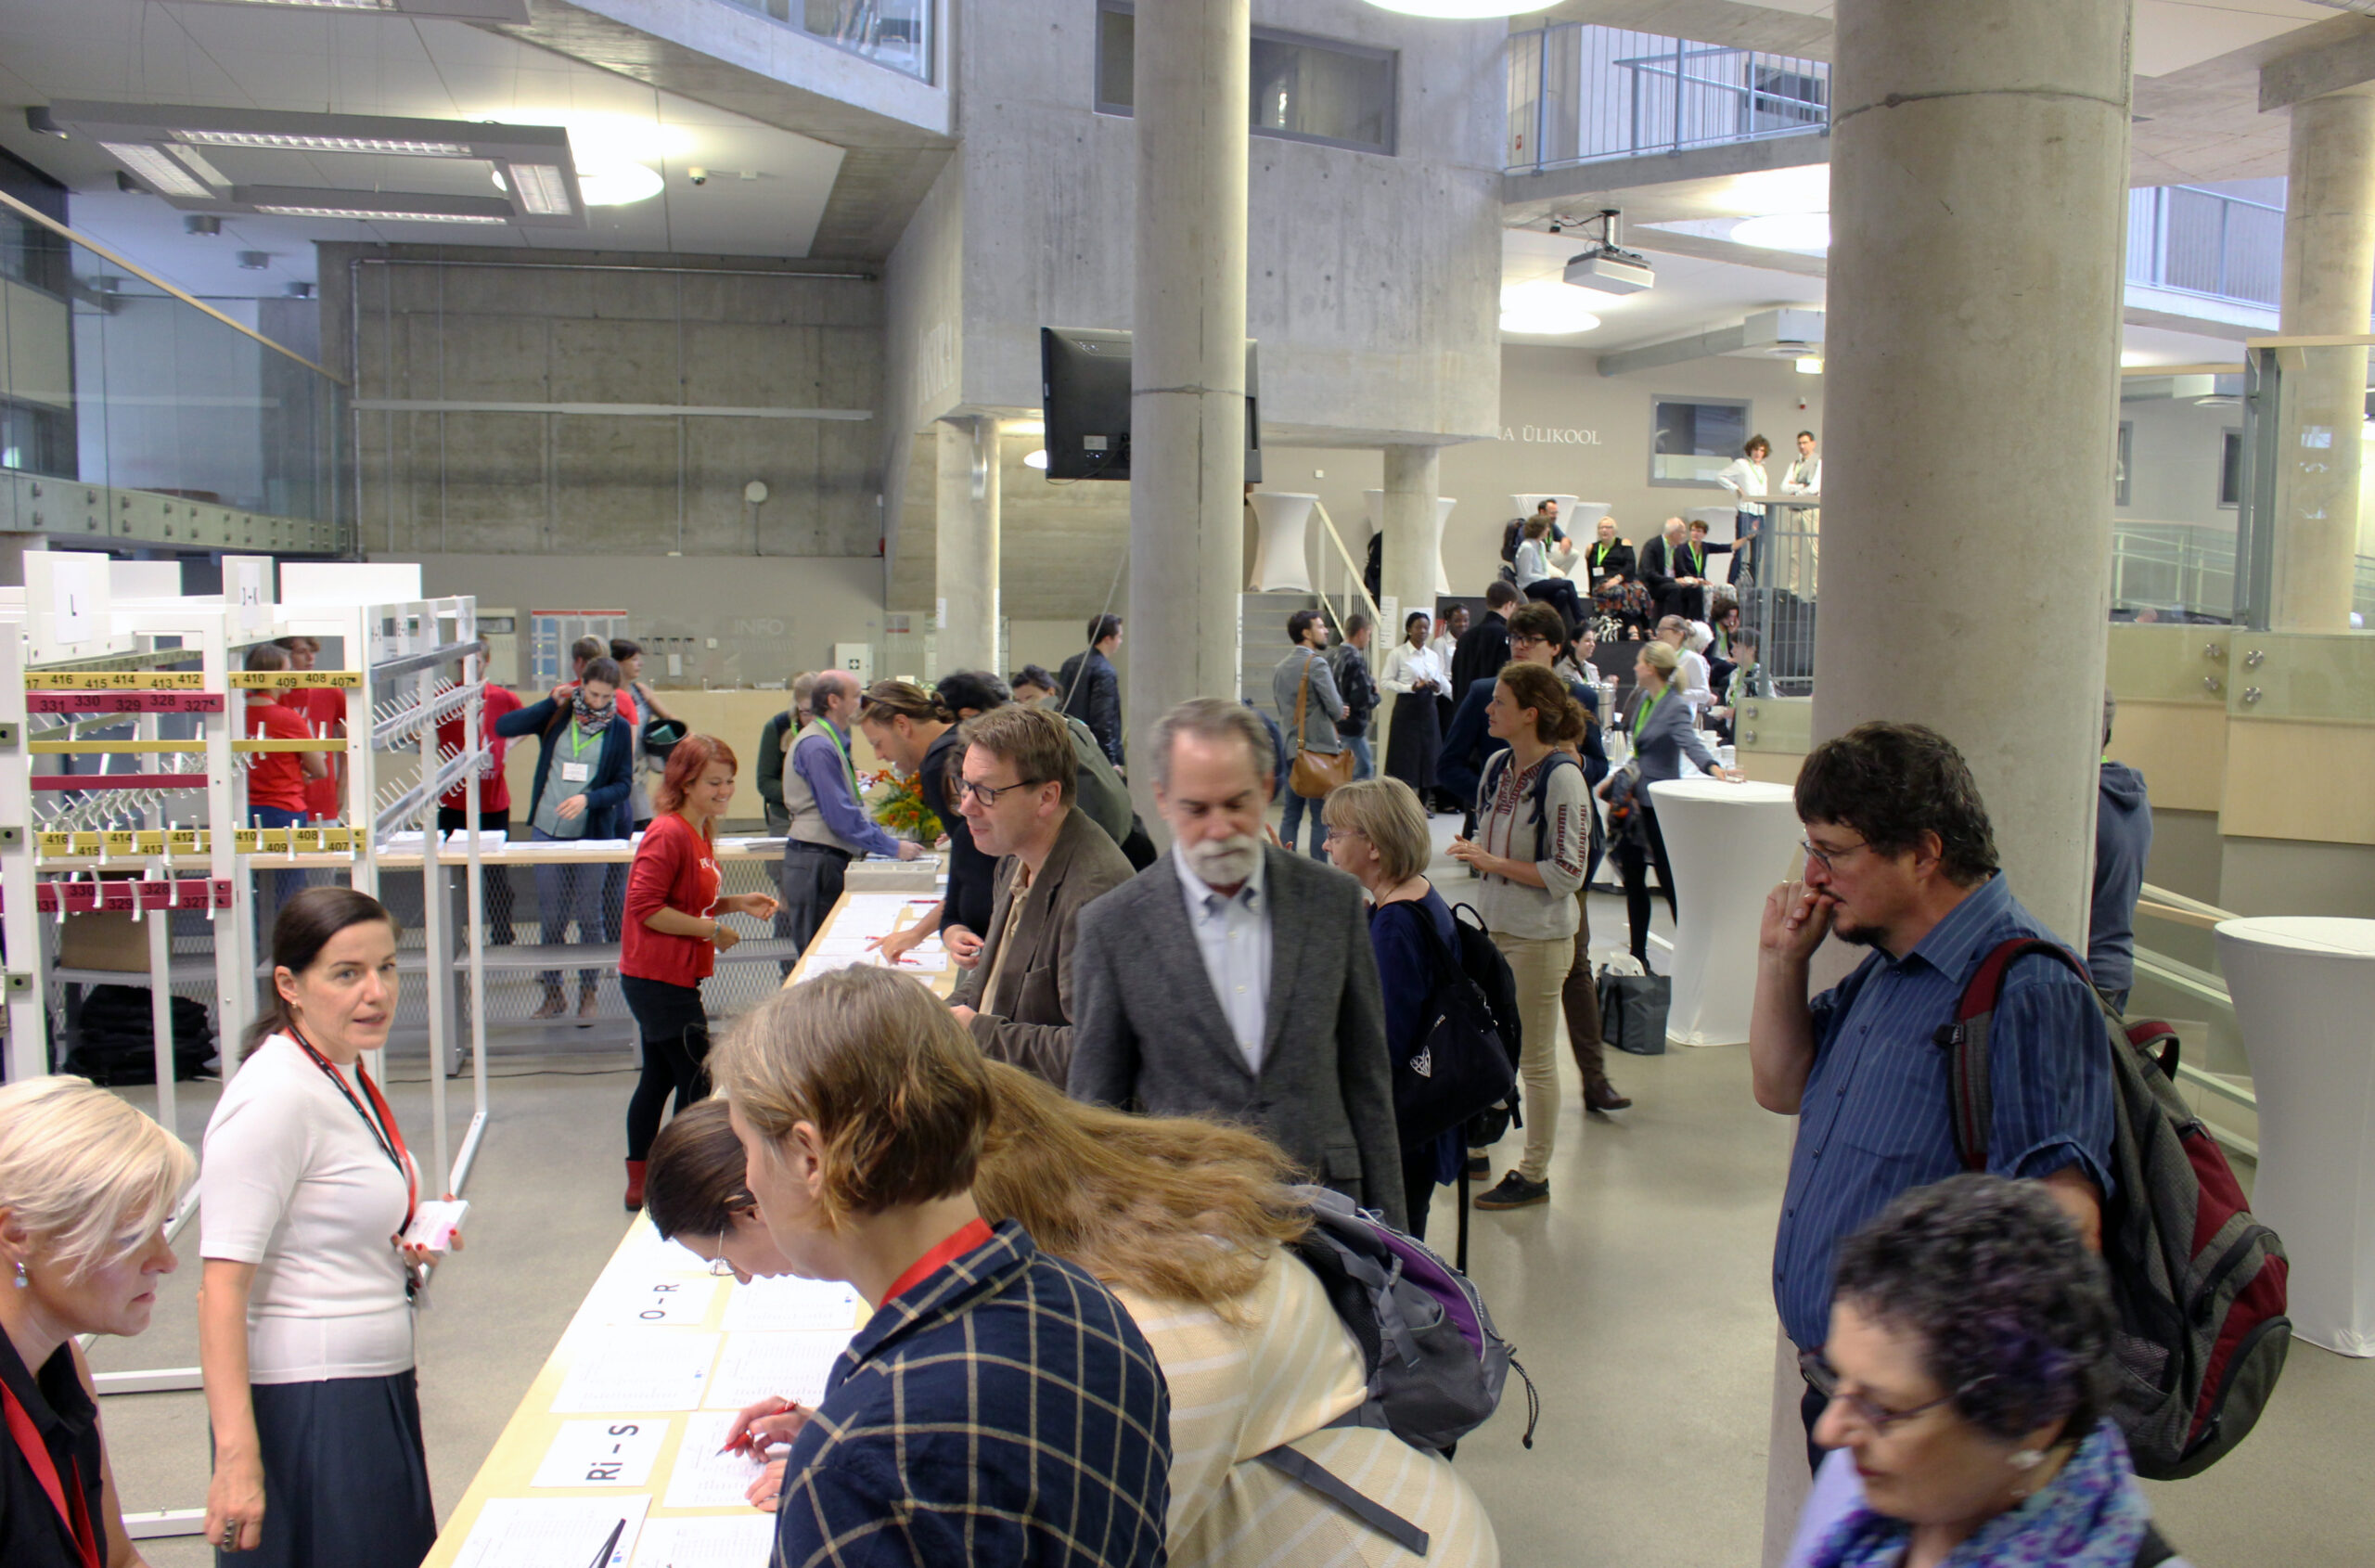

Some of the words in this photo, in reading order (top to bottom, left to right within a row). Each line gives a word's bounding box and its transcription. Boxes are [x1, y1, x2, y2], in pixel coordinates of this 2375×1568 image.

[1522, 425, 1601, 445] ÜLIKOOL
[734, 618, 784, 635] INFO
[50, 675, 73, 685] 416
[84, 678, 108, 689] 415
[113, 675, 136, 685] 414
[150, 678, 173, 689] 413
[177, 674, 200, 685] 412
[243, 674, 265, 684] 410
[276, 677, 298, 688] 409
[305, 673, 327, 684] 408
[330, 676, 352, 688] 407
[40, 700, 66, 713] 331
[74, 695, 101, 707] 330
[115, 699, 142, 712] 329
[149, 694, 176, 707] 328
[184, 700, 210, 713] 327
[45, 833, 69, 844] 416
[110, 832, 133, 843] 414
[173, 831, 196, 842] 412
[235, 831, 257, 842] 410
[297, 829, 319, 841] 408
[77, 845, 100, 856] 415
[141, 844, 164, 855] 413
[266, 842, 288, 853] 409
[327, 842, 350, 852] 407
[70, 884, 94, 897] 330
[145, 882, 170, 895] 328
[108, 898, 134, 910] 329
[183, 896, 209, 908] 327
[652, 1283, 681, 1292] R
[638, 1309, 667, 1320] O
[585, 1461, 624, 1482] Ri
[608, 1424, 640, 1437] S
